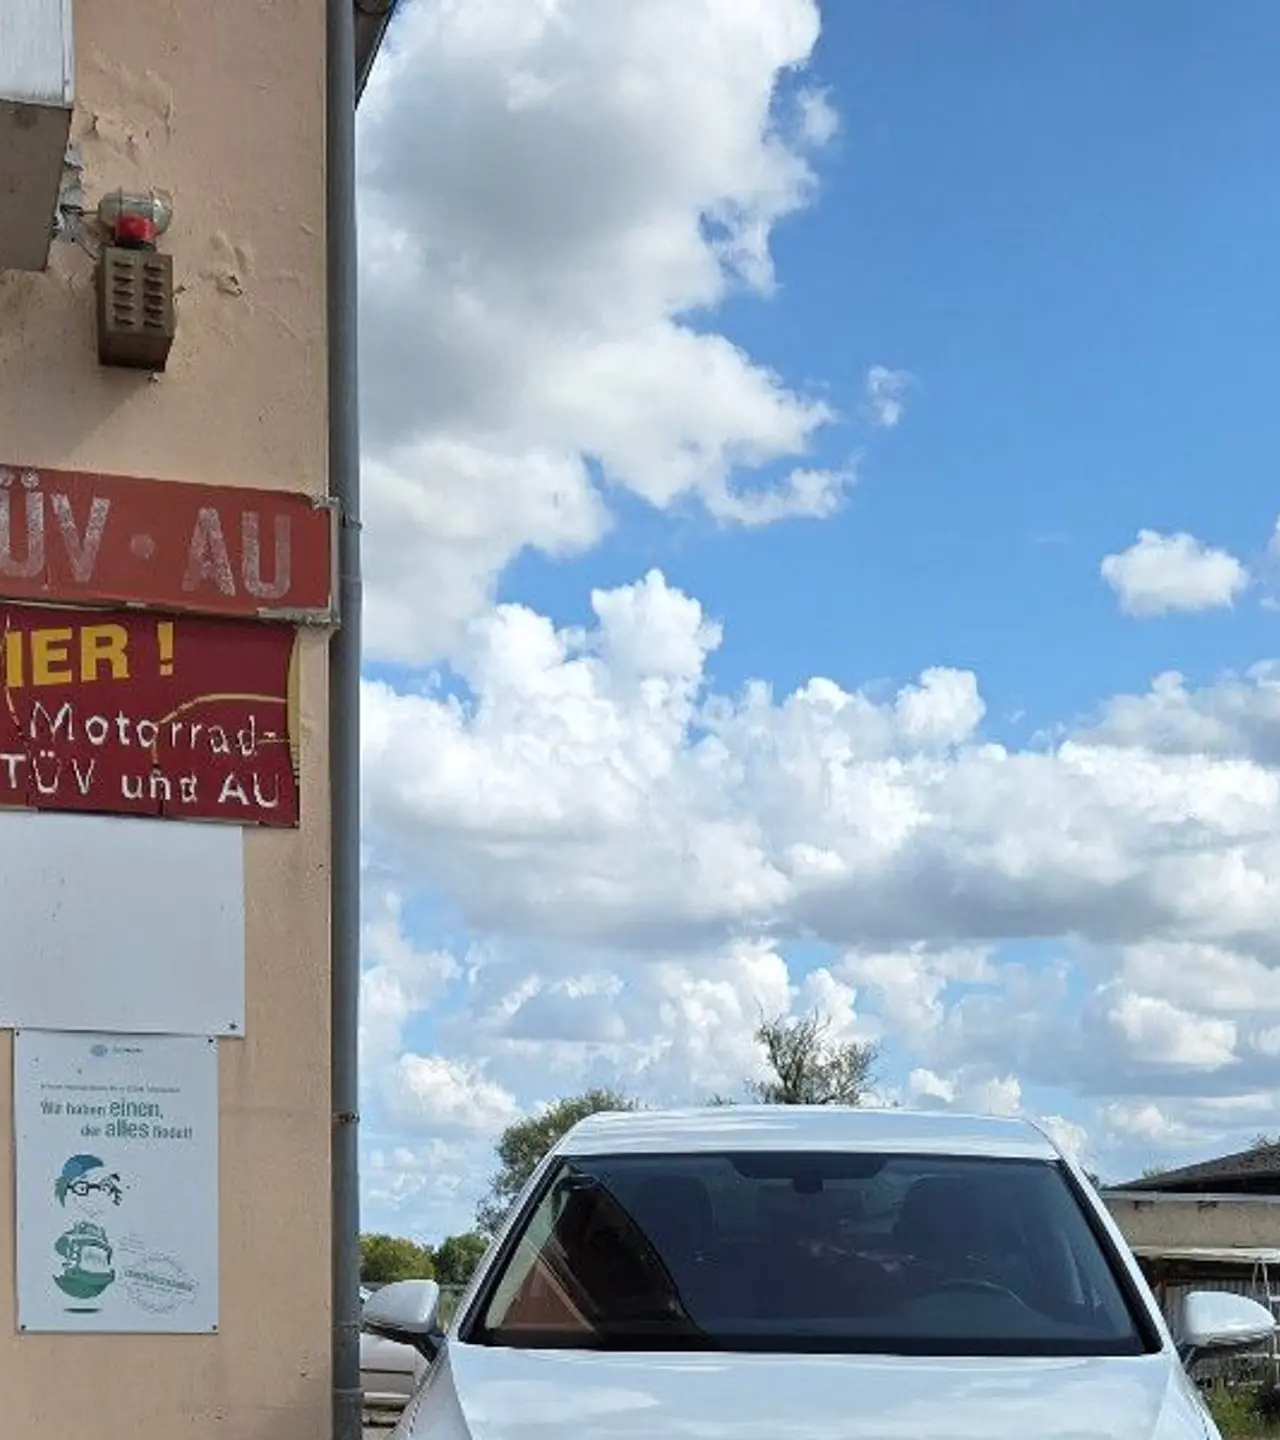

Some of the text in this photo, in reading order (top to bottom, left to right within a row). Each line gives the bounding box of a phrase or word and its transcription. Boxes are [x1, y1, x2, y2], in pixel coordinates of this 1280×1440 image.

[182, 505, 292, 599] AU
[29, 700, 277, 756] Motorrad-
[0, 749, 280, 809] TÜV und AU
[104, 1119, 149, 1139] alles
